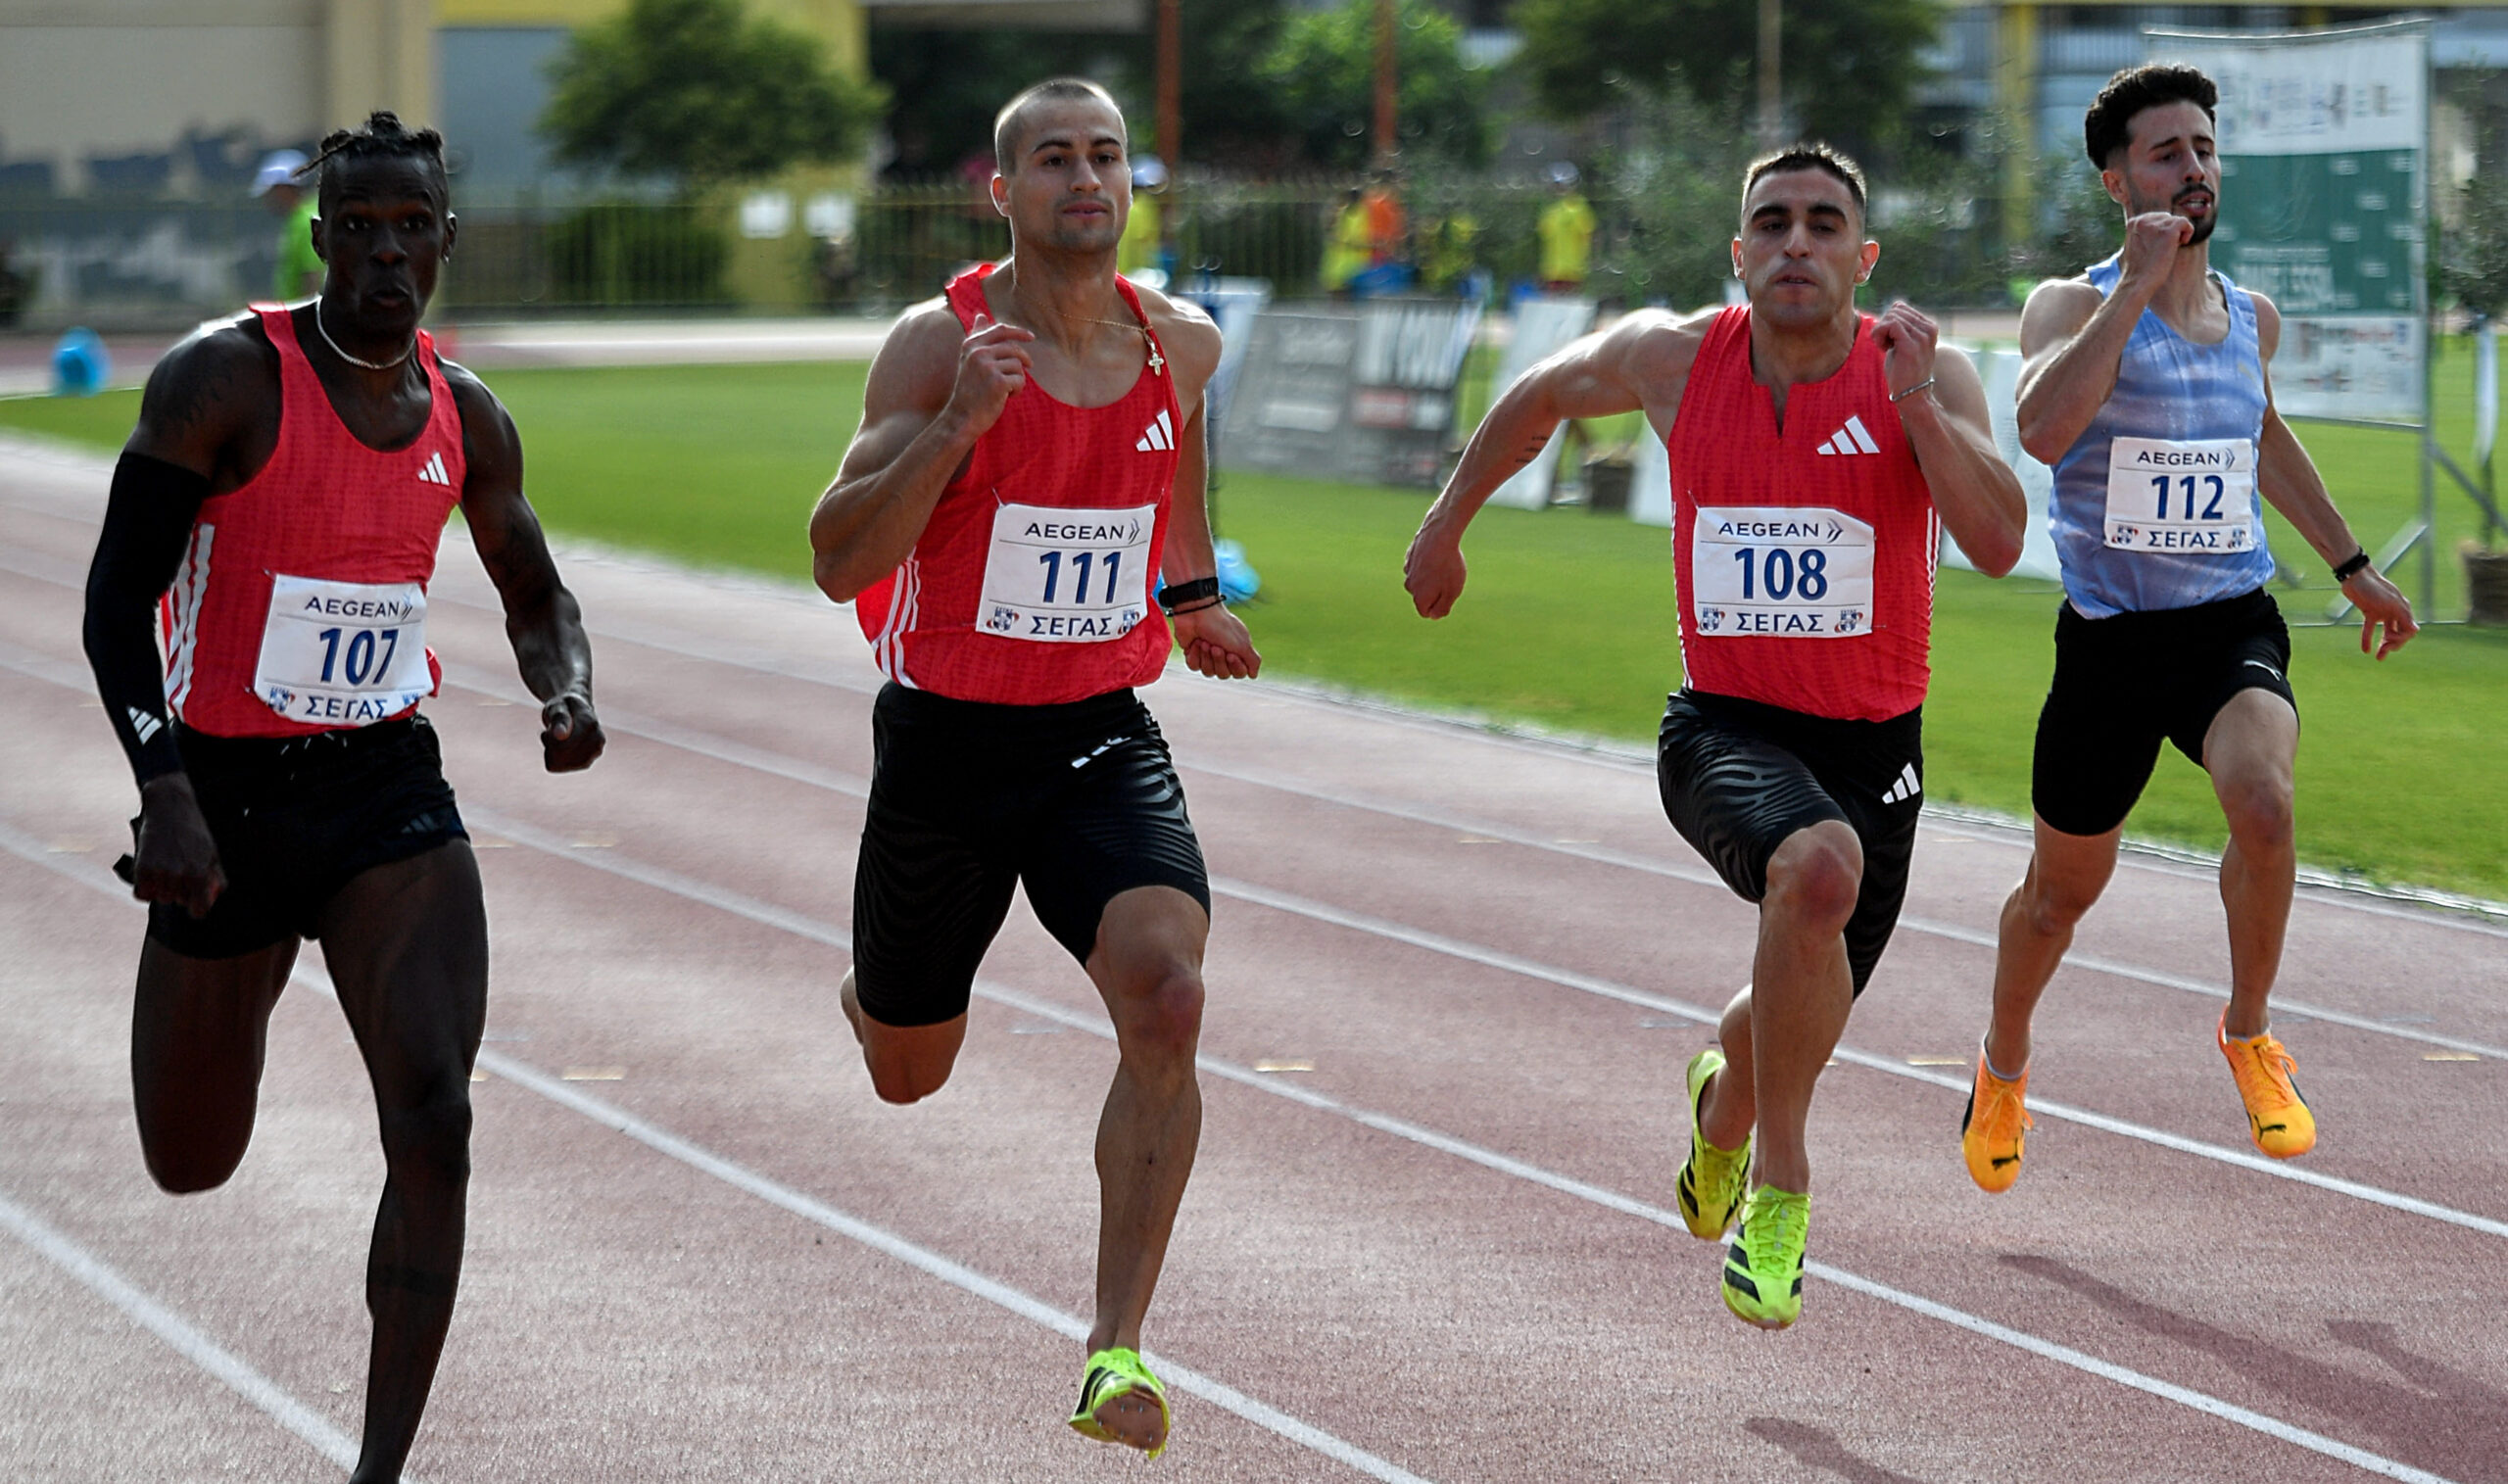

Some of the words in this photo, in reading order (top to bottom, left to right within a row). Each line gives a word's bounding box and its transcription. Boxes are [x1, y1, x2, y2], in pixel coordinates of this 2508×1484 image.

[2137, 451, 2221, 465] AEGEAN
[2151, 475, 2225, 520] 112
[1025, 522, 1125, 540] AEGEAN
[1718, 522, 1819, 538] AEGEAN
[2147, 531, 2221, 548] ΣΕΓΑΣ
[1039, 551, 1122, 604] 111
[1734, 548, 1828, 601] 108
[304, 596, 400, 619] AEGEAN
[1029, 615, 1113, 637] ΣΕΓΑΣ
[1736, 612, 1824, 633] ΣΕΓΑΣ
[318, 627, 400, 687] 107
[304, 694, 389, 720] ΣΕΓΑΣ
